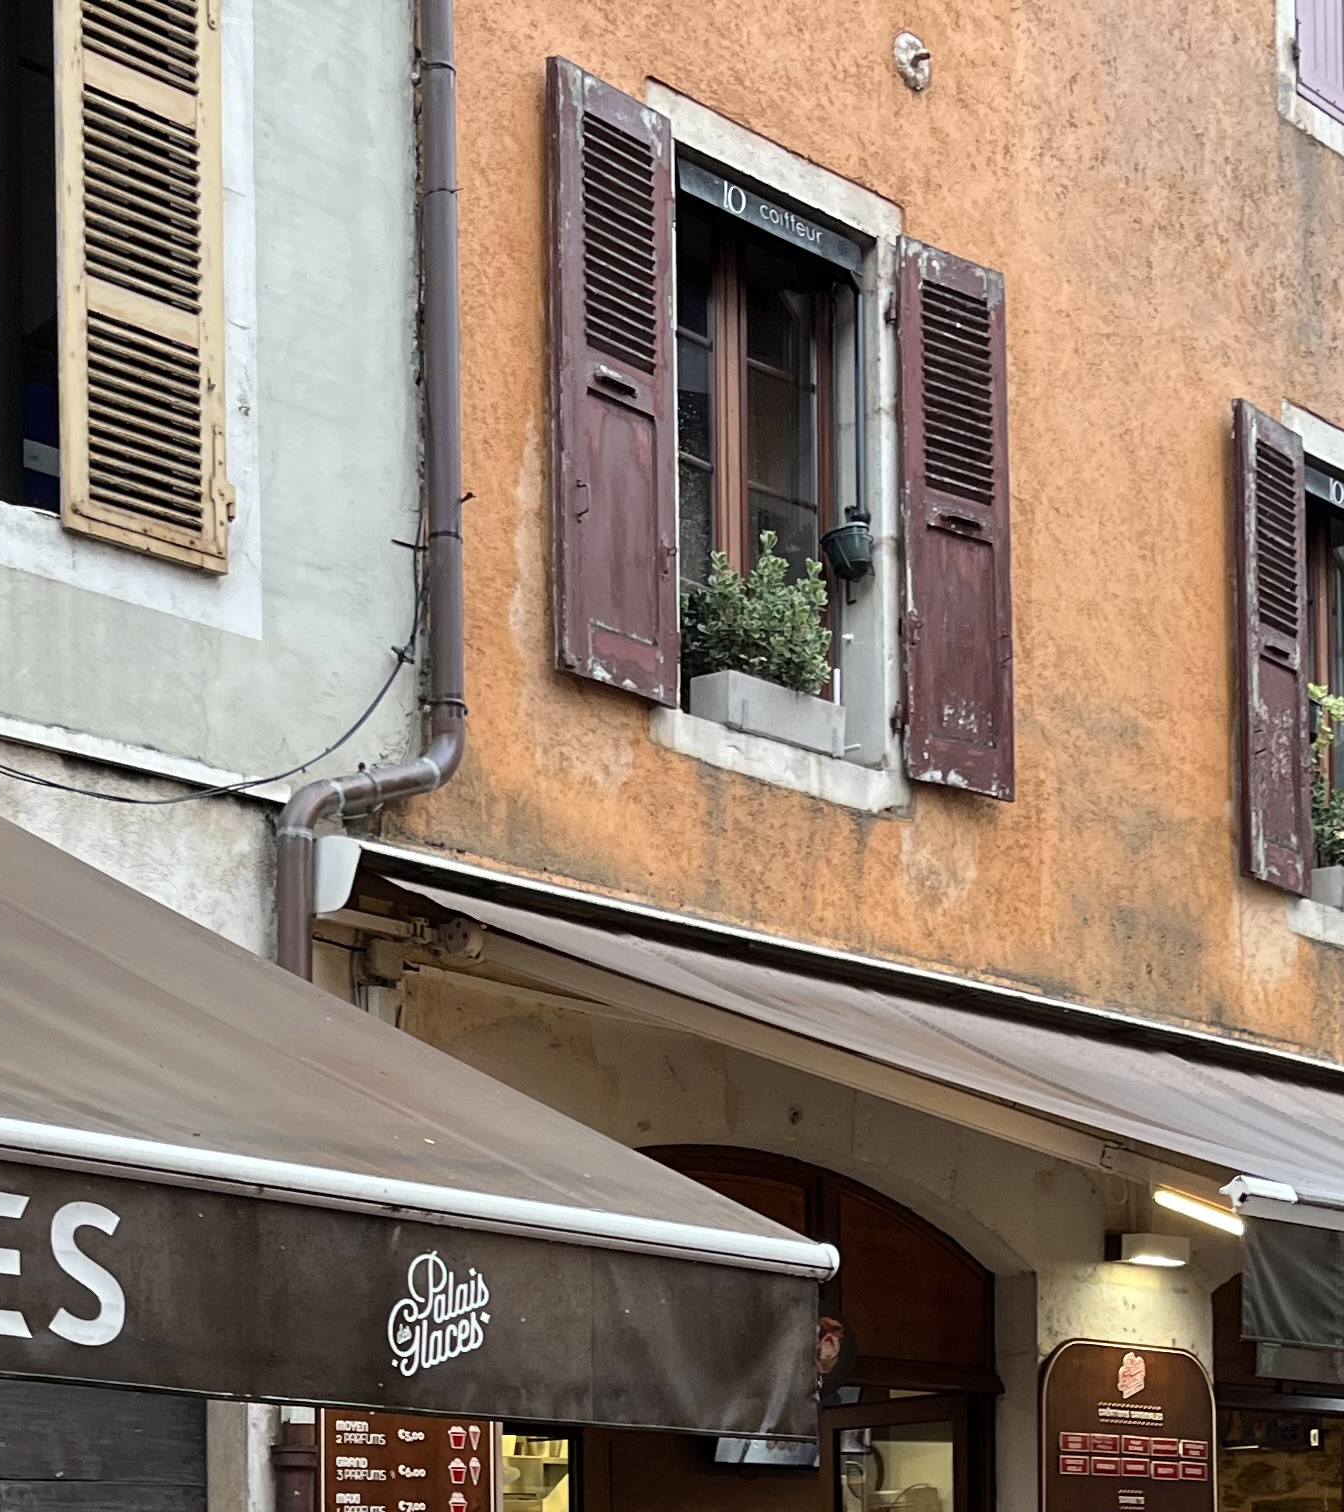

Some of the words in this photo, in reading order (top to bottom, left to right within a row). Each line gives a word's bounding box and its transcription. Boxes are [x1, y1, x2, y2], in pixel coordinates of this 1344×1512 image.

[759, 203, 823, 244] coiffeur
[407, 1249, 490, 1324] Palais
[387, 1298, 484, 1377] Glaces
[335, 1434, 343, 1444] 2
[344, 1433, 386, 1445] PARFUMS
[336, 1469, 344, 1481] 3
[344, 1469, 387, 1481] PARFUMS
